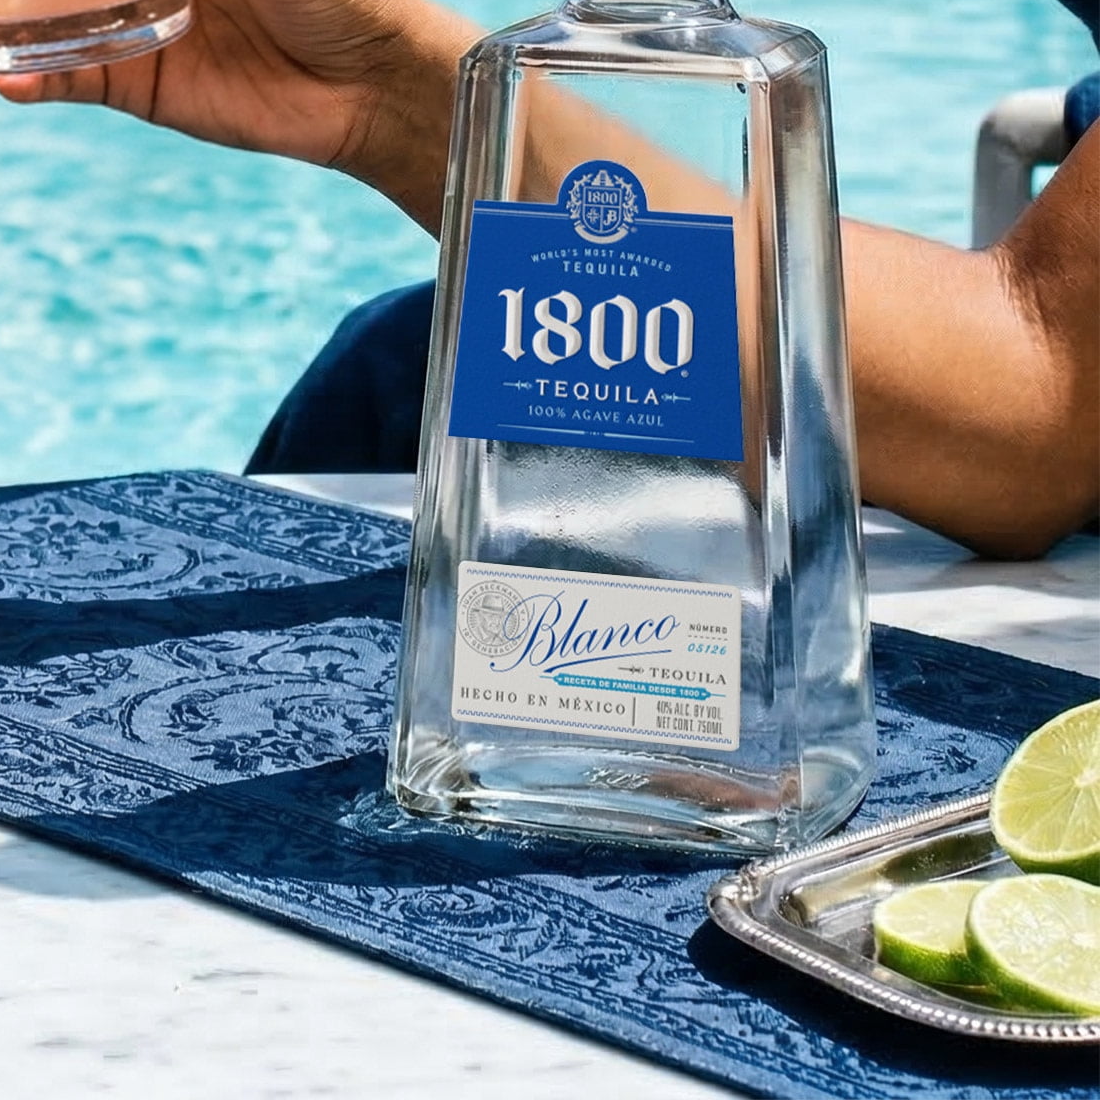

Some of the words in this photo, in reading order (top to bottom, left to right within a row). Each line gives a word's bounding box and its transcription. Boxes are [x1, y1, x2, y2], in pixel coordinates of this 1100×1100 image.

[587, 191, 618, 204] 1800
[530, 249, 578, 263] WORLD'S
[584, 248, 615, 258] MOST
[619, 251, 672, 272] AWARDED
[562, 260, 639, 277] TEQUILA
[498, 287, 694, 375] 1800
[536, 379, 660, 405] TEQUILA
[528, 405, 566, 419] 100%
[572, 409, 621, 424] AGAVE
[626, 414, 665, 428] AZUL
[489, 589, 681, 673] Blanco
[689, 622, 728, 635] NÚMERO
[687, 643, 728, 656] 05126
[563, 676, 597, 686] RECETA
[599, 680, 611, 688] DE
[612, 681, 647, 691] FAMILIA
[648, 685, 677, 695] DESDE
[680, 688, 700, 698] 1800
[649, 667, 728, 686] TEQUILA
[460, 686, 518, 703] HECHO
[527, 694, 548, 707] EN
[558, 696, 626, 715] MÉXICO
[656, 700, 673, 715] 40%
[694, 704, 705, 718] BY
[656, 715, 671, 729] NET
[697, 720, 723, 736] 750ML
